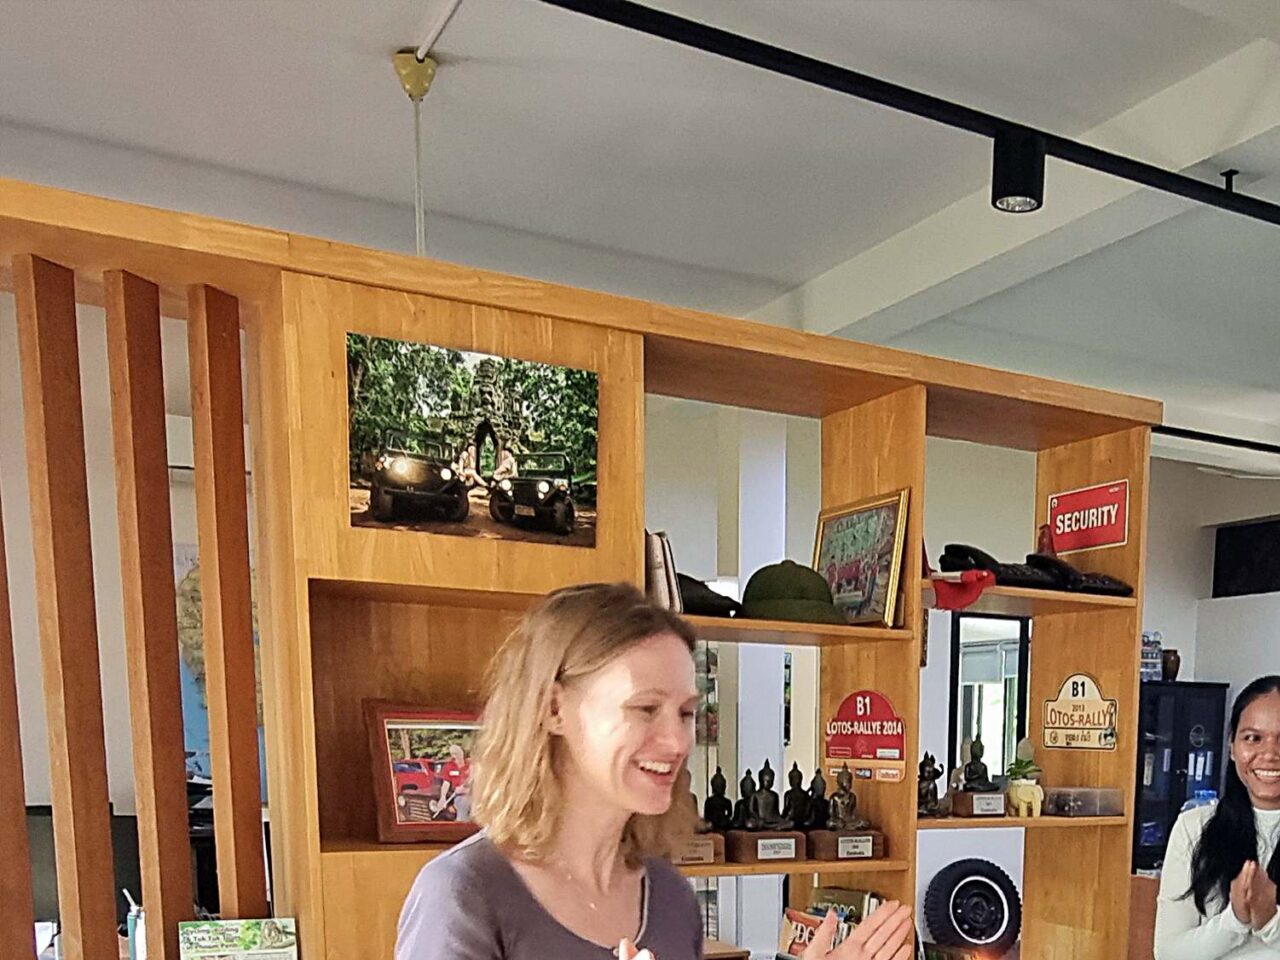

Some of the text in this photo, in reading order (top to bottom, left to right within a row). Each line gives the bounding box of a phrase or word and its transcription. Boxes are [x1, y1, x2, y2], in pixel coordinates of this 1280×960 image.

[1056, 503, 1118, 535] SECURITY
[1071, 681, 1086, 698] B1
[856, 696, 870, 716] B1
[826, 721, 902, 735] LOTOS-RALLYE 2014
